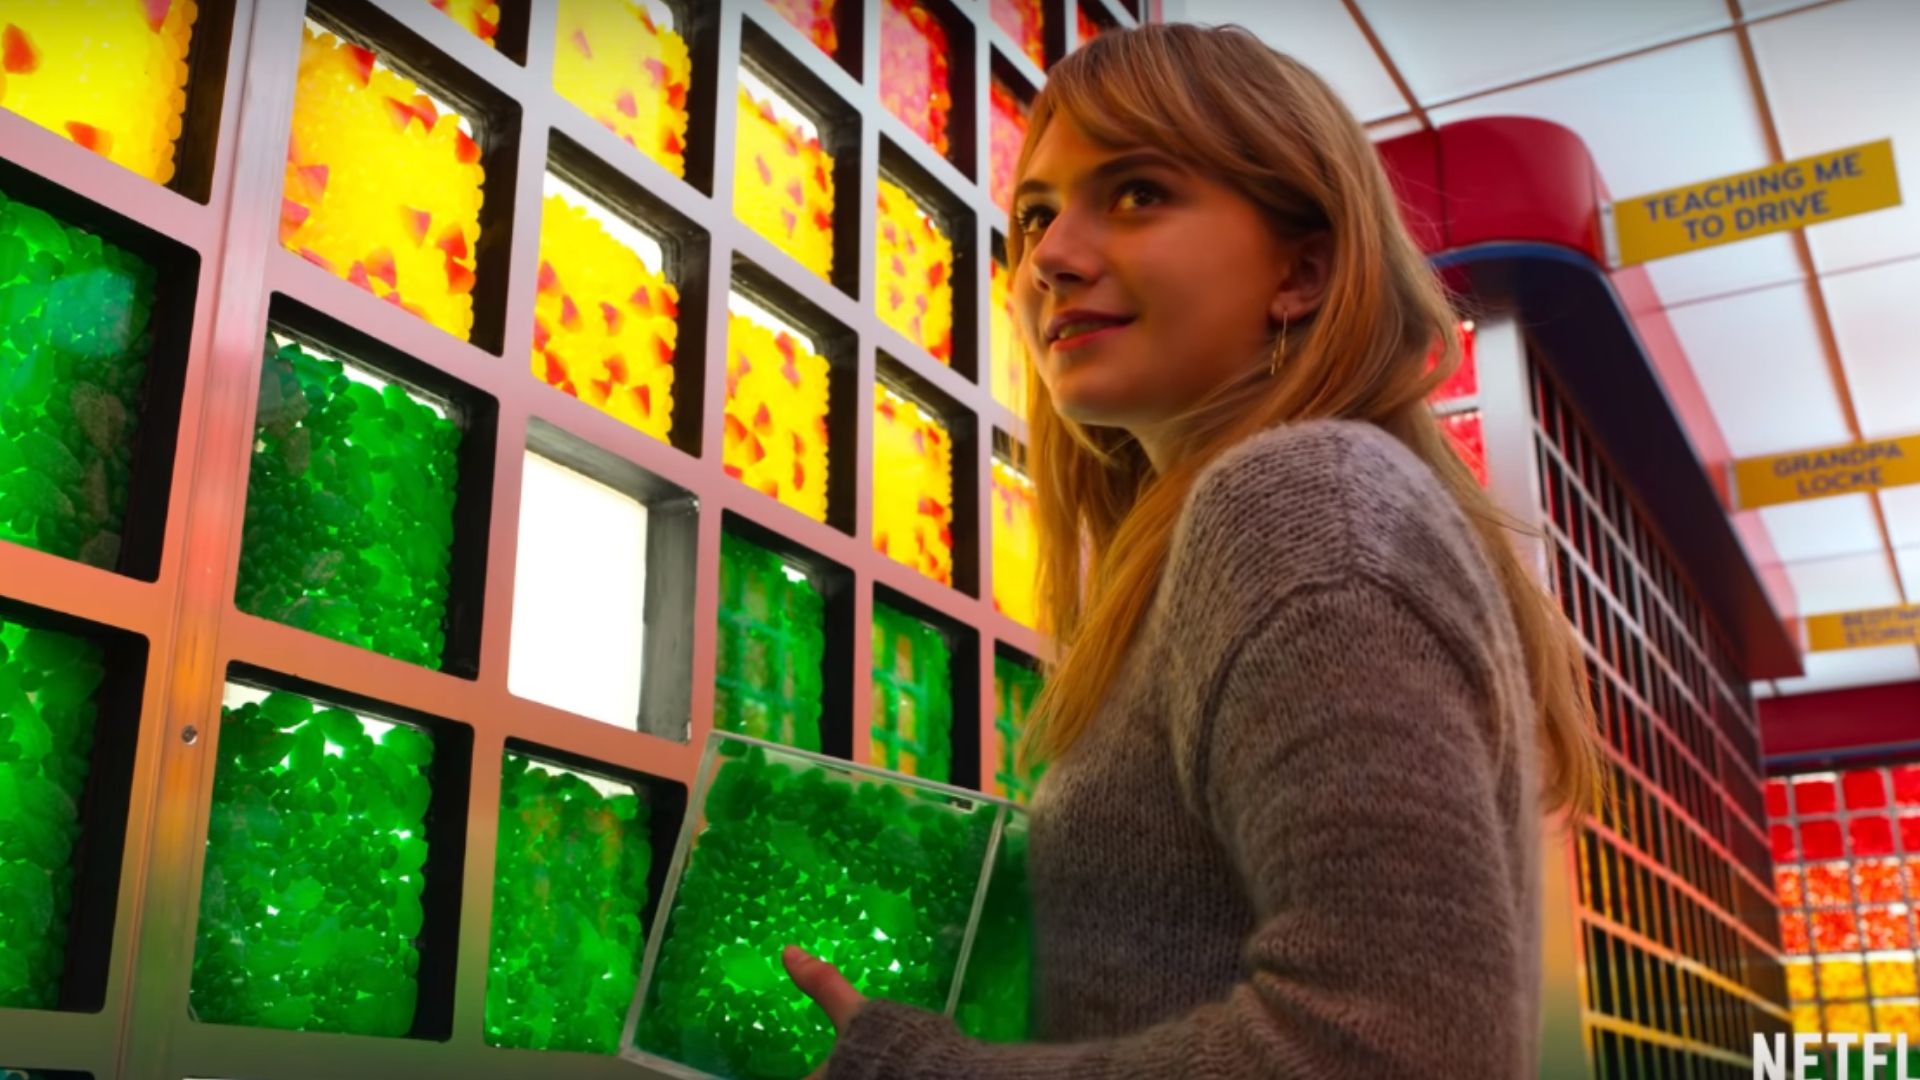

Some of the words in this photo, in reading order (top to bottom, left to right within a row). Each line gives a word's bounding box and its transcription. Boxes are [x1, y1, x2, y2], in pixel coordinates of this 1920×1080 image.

[1644, 167, 1805, 222] TEACHING
[1814, 152, 1862, 183] ME
[1682, 214, 1724, 242] TO
[1735, 189, 1829, 231] DRIVE
[1773, 441, 1903, 477] GRANDPA
[1797, 467, 1882, 496] LOCKE
